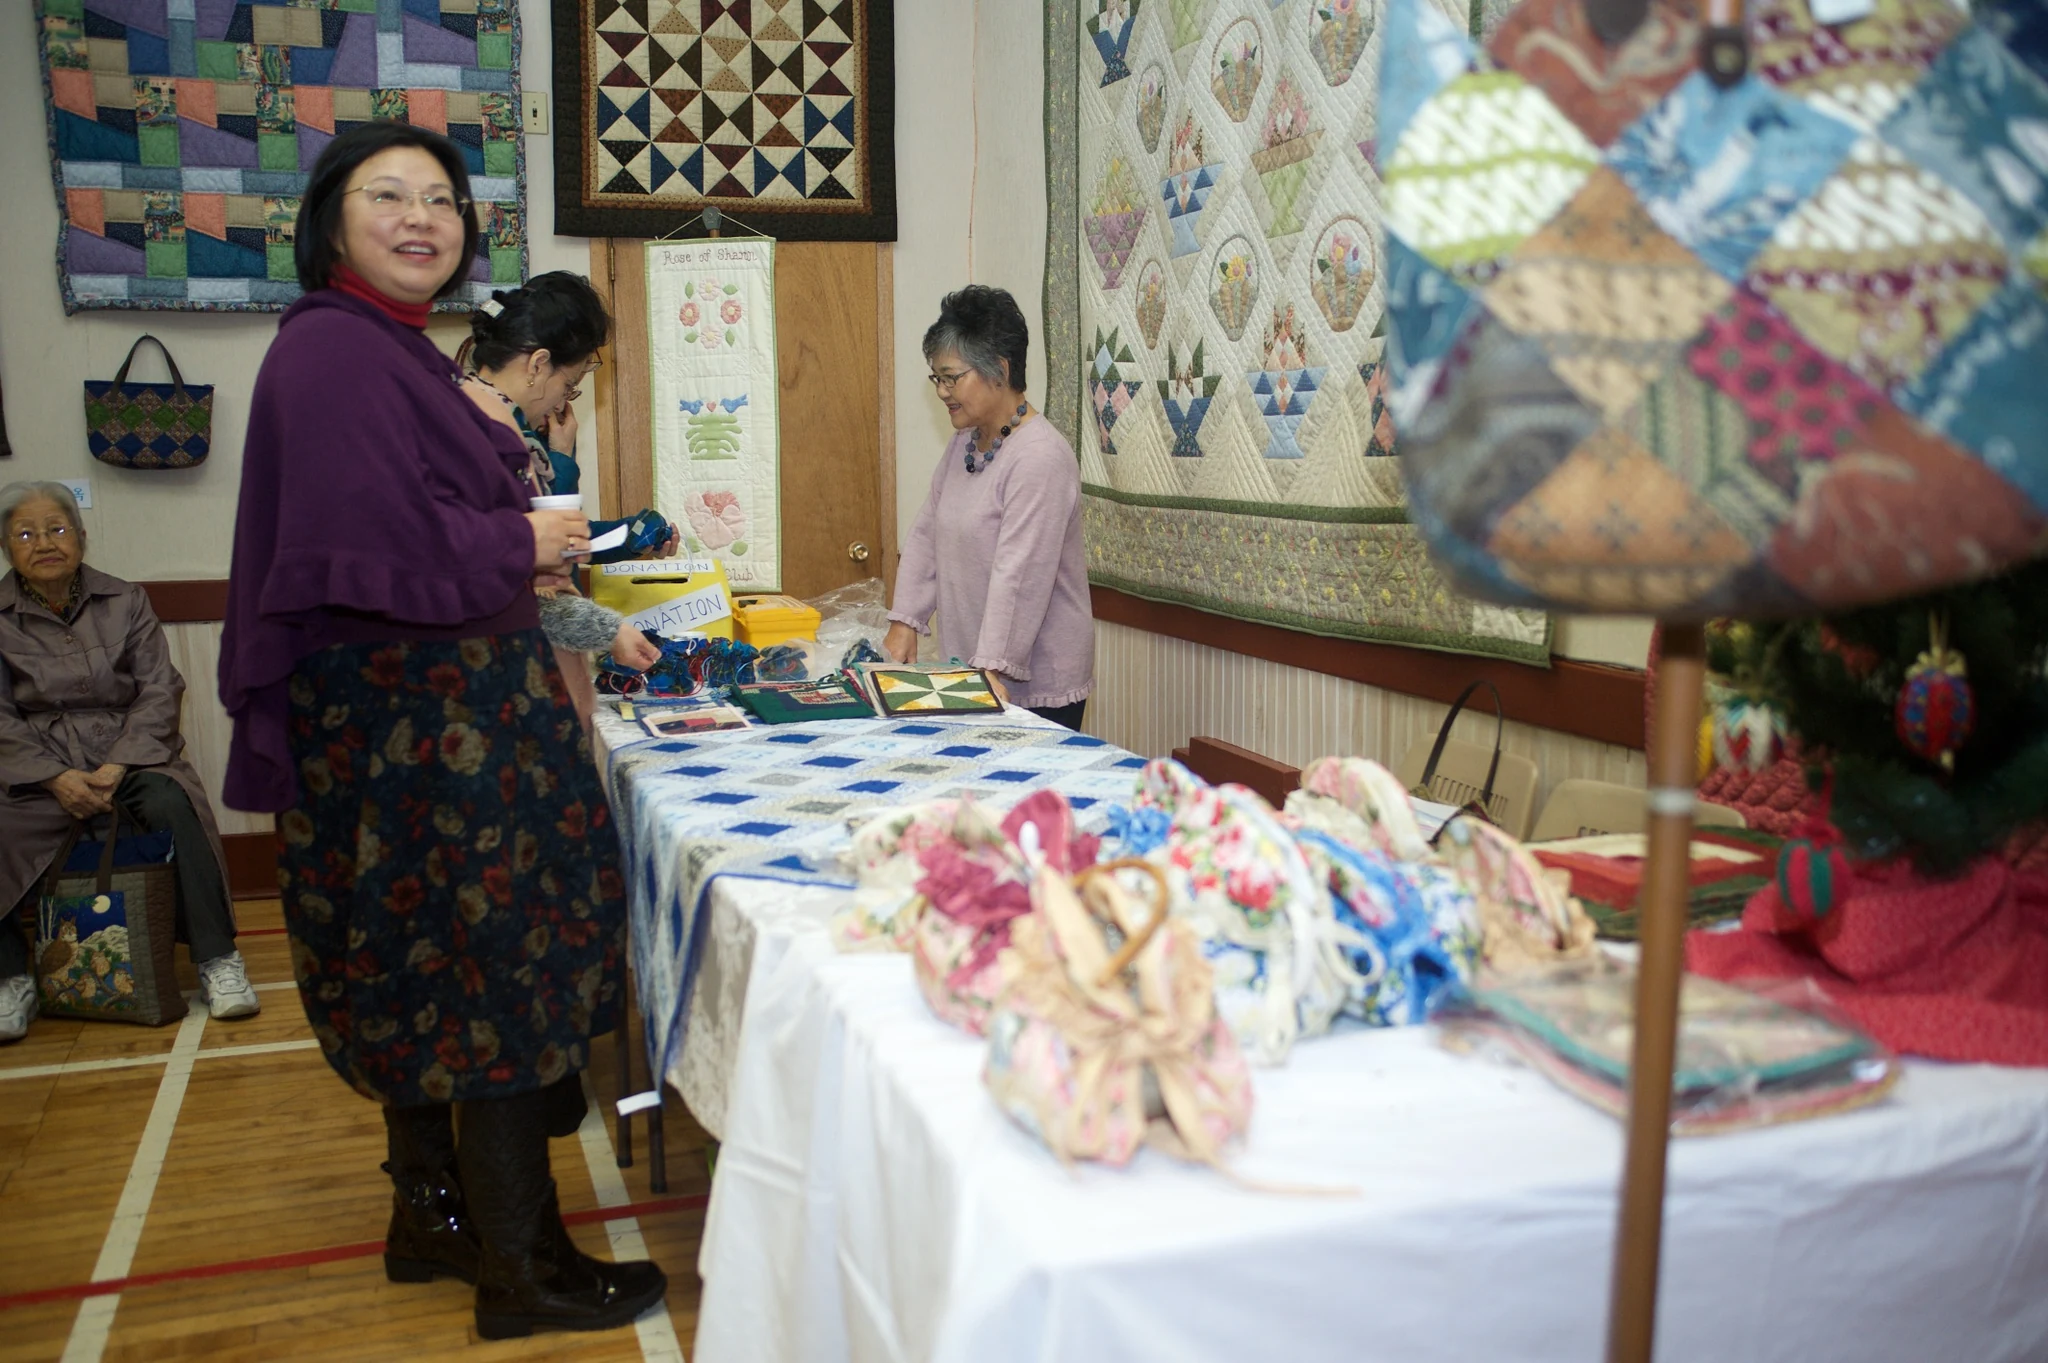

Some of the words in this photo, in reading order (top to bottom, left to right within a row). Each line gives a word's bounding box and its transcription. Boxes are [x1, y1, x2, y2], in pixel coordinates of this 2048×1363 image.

[663, 250, 692, 265] Rose
[698, 248, 711, 262] of
[604, 562, 709, 574] DONATION
[633, 594, 722, 632] ONATION
